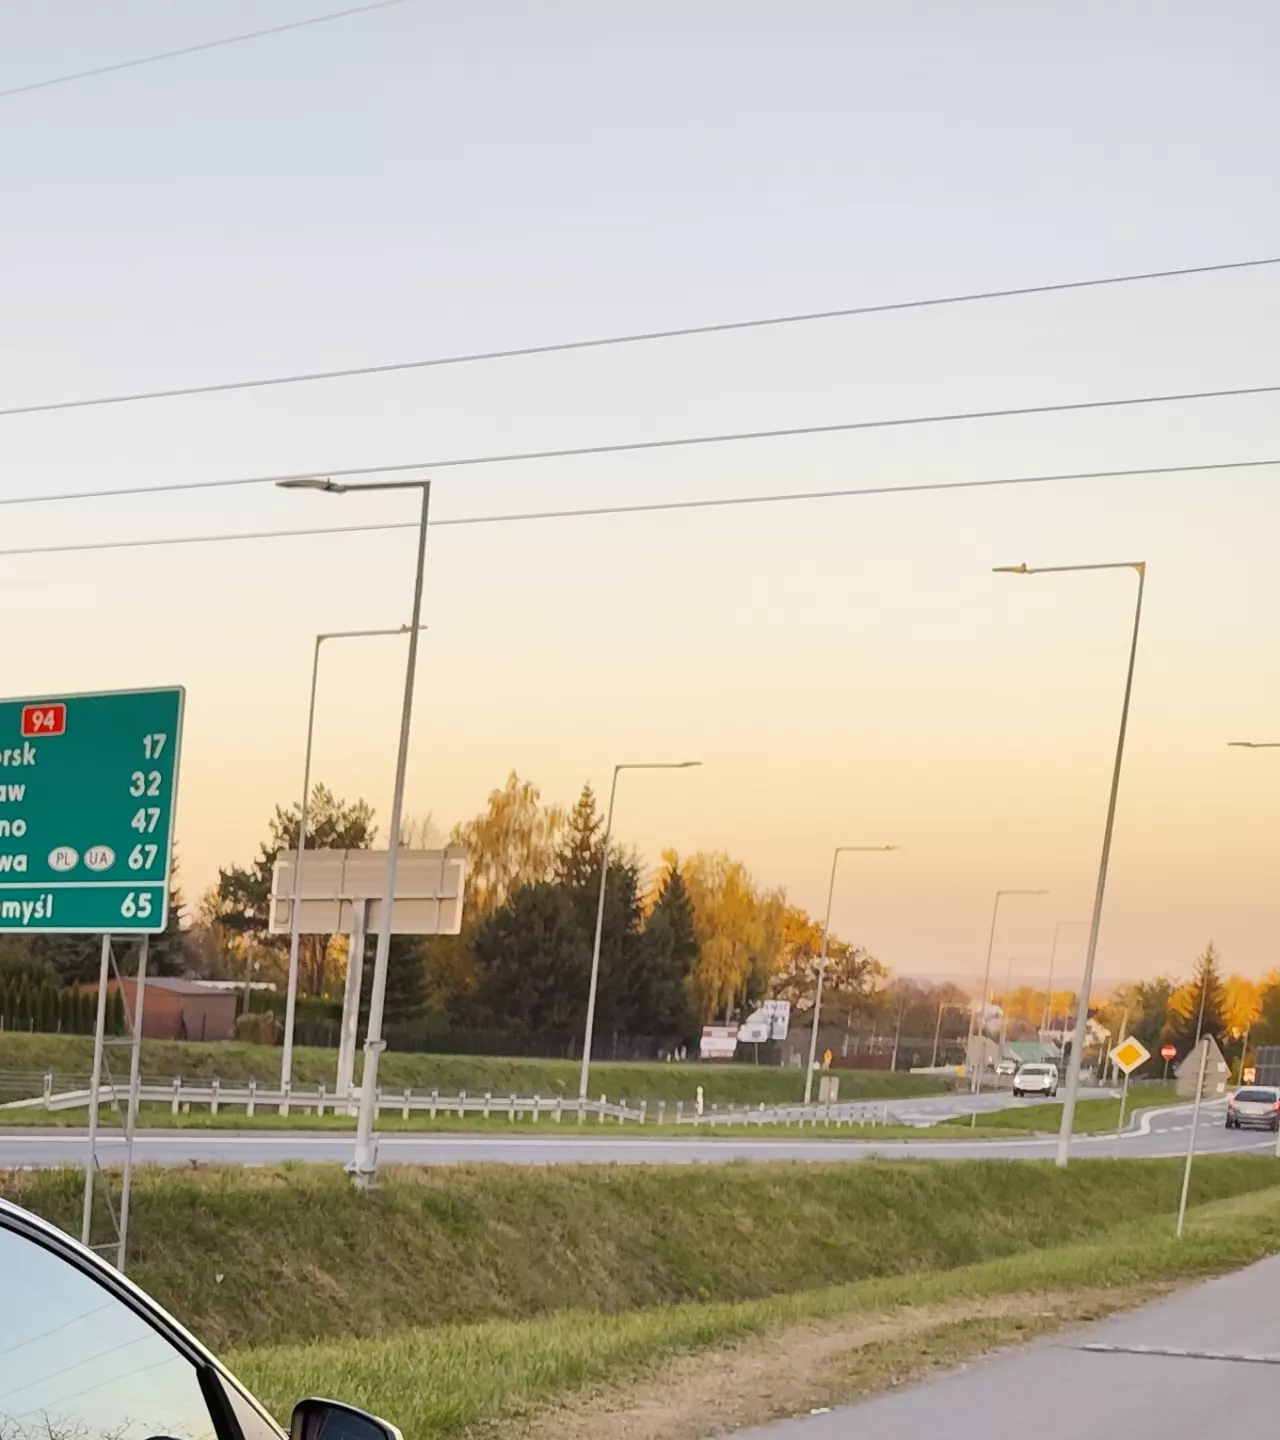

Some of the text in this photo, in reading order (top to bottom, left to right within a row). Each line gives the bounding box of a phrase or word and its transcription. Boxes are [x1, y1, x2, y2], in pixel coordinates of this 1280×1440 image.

[31, 709, 56, 732] 94
[142, 733, 167, 760] 17
[129, 771, 162, 797] 32
[130, 807, 161, 834] 47
[56, 852, 70, 866] PL
[89, 852, 108, 865] UA
[128, 844, 158, 870] 67
[120, 892, 153, 918] 65
